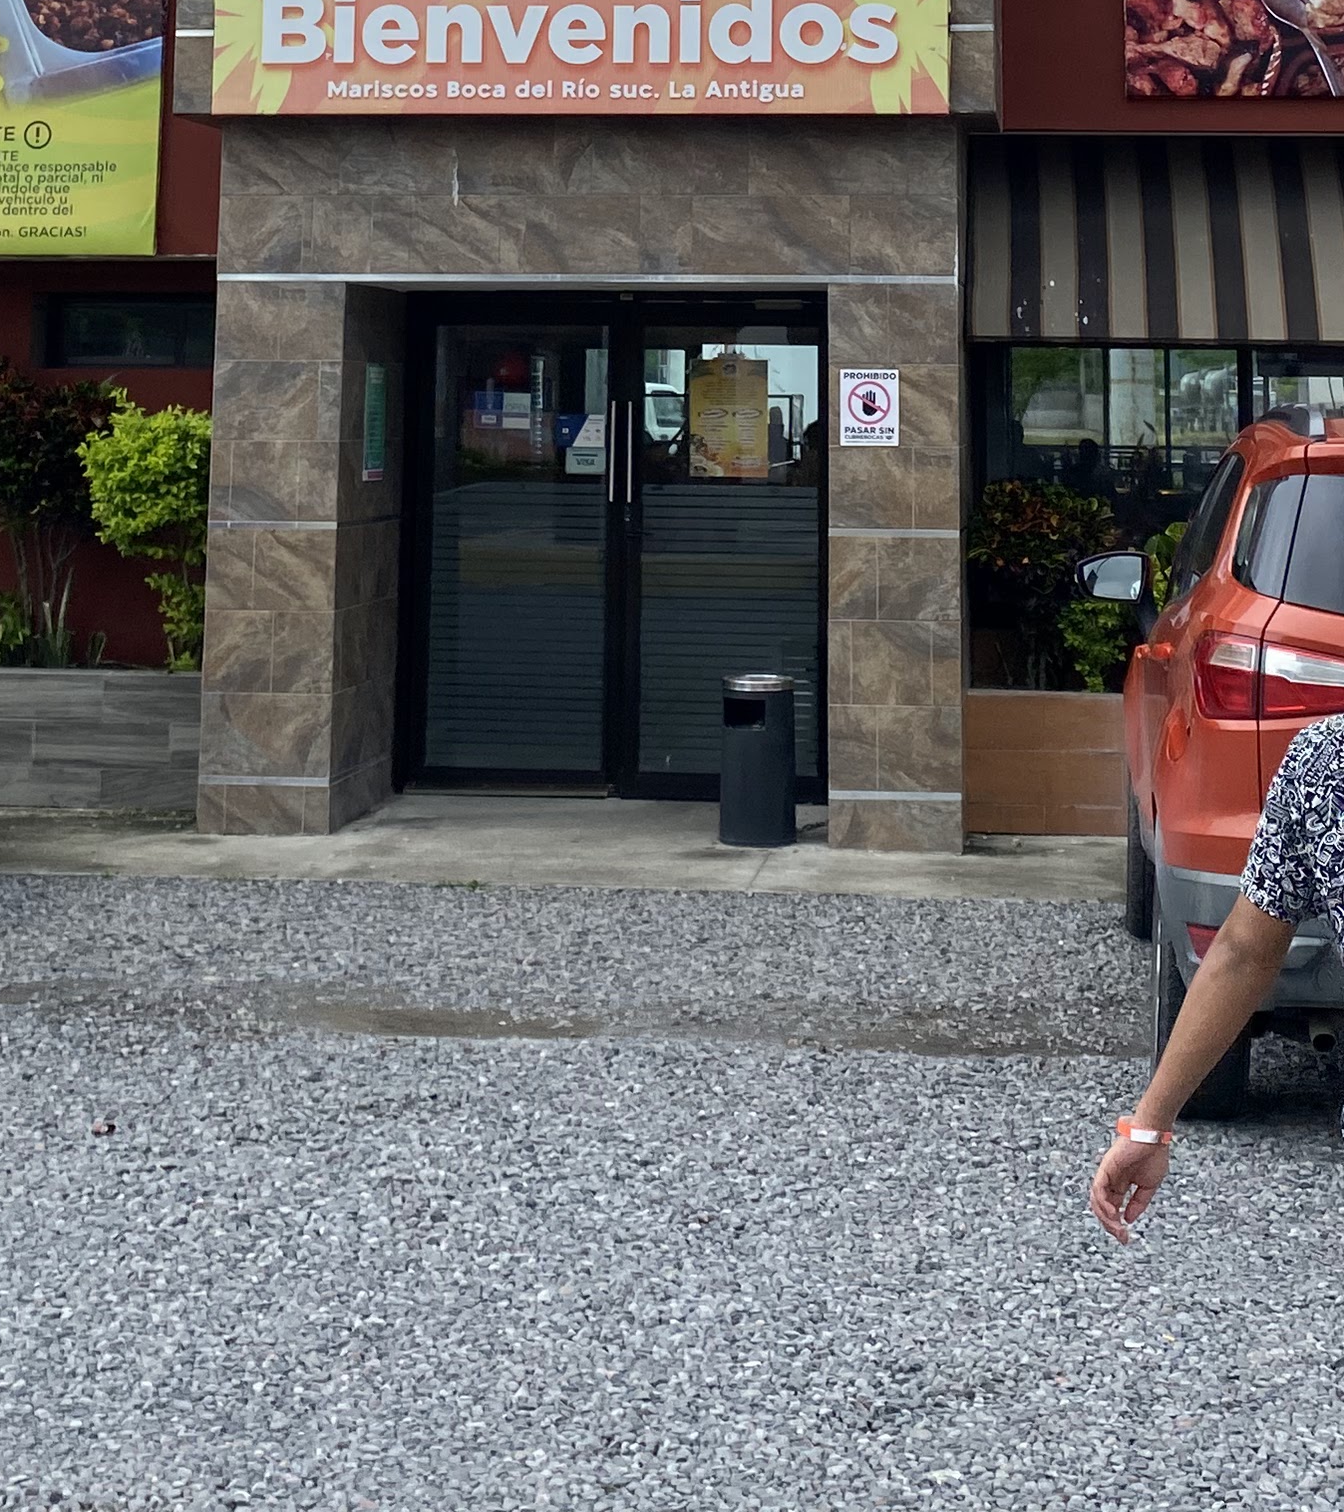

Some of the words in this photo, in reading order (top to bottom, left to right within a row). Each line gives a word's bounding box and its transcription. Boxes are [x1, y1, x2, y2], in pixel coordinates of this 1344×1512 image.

[327, 80, 439, 100] Mariscos
[446, 81, 507, 100] Boca
[513, 80, 553, 99] del
[560, 78, 601, 99] Río
[609, 84, 661, 100] suc.
[668, 80, 696, 99] La
[706, 79, 806, 104] Antigua
[34, 161, 117, 176] responsable
[24, 174, 33, 183] o
[38, 172, 88, 187] parcial,
[92, 172, 104, 183] ni
[45, 185, 71, 197] que
[59, 196, 68, 205] u
[2, 205, 48, 216] dentro
[52, 205, 74, 215] del
[18, 226, 87, 238] GRACIAS!
[843, 372, 896, 380] PROHIBIDO
[844, 426, 876, 434] PASAR
